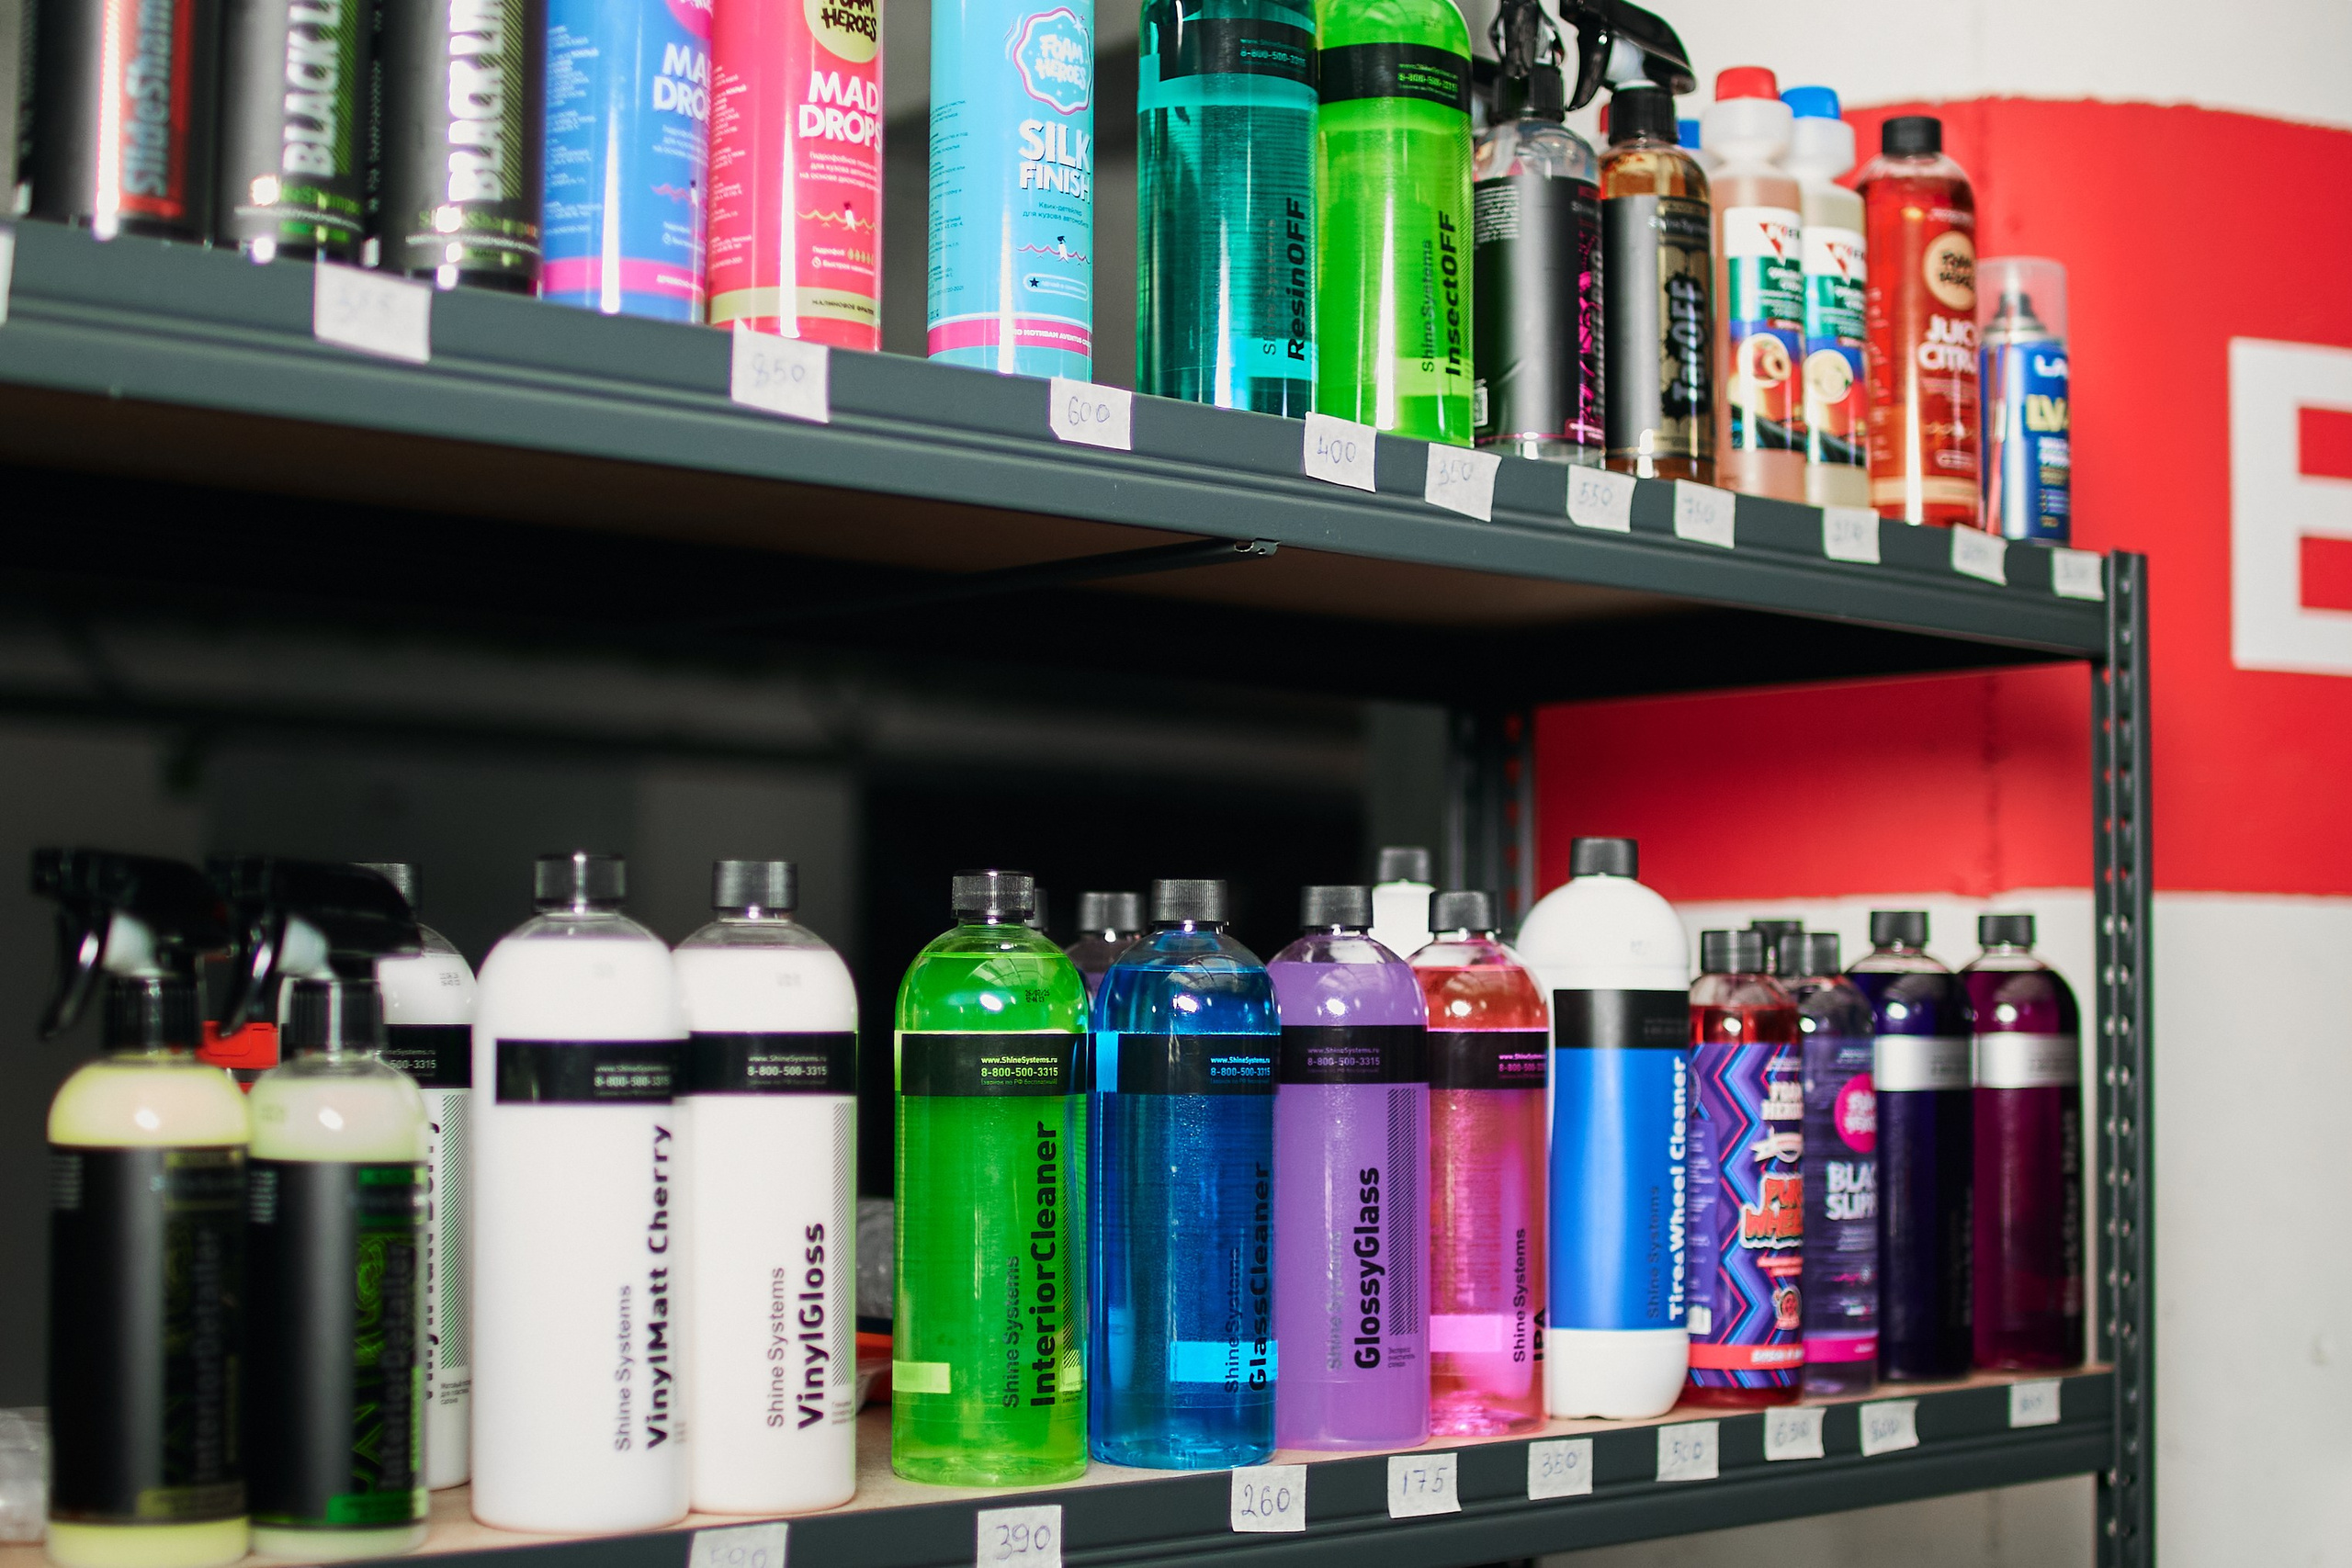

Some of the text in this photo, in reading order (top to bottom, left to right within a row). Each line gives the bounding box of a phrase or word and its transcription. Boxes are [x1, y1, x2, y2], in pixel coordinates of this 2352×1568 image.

[821, 8, 876, 42] HEROES
[1039, 34, 1084, 64] FOAM
[662, 42, 711, 87] MA
[1035, 57, 1086, 90] HEROES
[282, 30, 339, 177] BLACK
[652, 75, 711, 123] DRO
[808, 71, 879, 116] MAD
[798, 104, 883, 154] DROPS
[1018, 119, 1091, 175] SILK
[1019, 162, 1091, 205] FINISH
[1287, 197, 1306, 362] ResinOFF
[1439, 209, 1461, 377] InsectOFF
[1421, 239, 1436, 372] Shine Systems
[1670, 278, 1707, 403] TarOFF
[1068, 395, 1110, 426] 600
[1317, 434, 1357, 465] 400
[747, 1066, 827, 1077] 8-800-500-3315
[980, 1055, 1058, 1066] www.ShineSystems.ru
[980, 1067, 1058, 1077] 8-800-500-3315
[1210, 1066, 1271, 1077] 8-800-500-3315
[1307, 1056, 1380, 1066] 8-800-500-3315
[1668, 1055, 1687, 1161] Cleaner
[1827, 1161, 1876, 1193] BLA
[1030, 1121, 1057, 1407] InteriorCleaner
[1249, 1161, 1271, 1392] GlassCleaner
[1353, 1166, 1385, 1370] GlossyGlass
[1647, 1186, 1662, 1319] Shine Systems
[646, 1123, 674, 1450] VinylMatt Cherry
[1327, 1230, 1344, 1372] Shine Systems
[1513, 1227, 1528, 1363] Shine Systems
[797, 1223, 830, 1430] VinylGloss
[1003, 1256, 1022, 1409] Shine Systems
[1225, 1247, 1242, 1393] Shine Systems
[615, 1284, 636, 1452] Shine Systems
[767, 1267, 789, 1428] Shine Systems
[1402, 1467, 1448, 1496] 175
[1543, 1450, 1577, 1479] 350
[1240, 1483, 1291, 1517] 260
[996, 1523, 1052, 1561] 390
